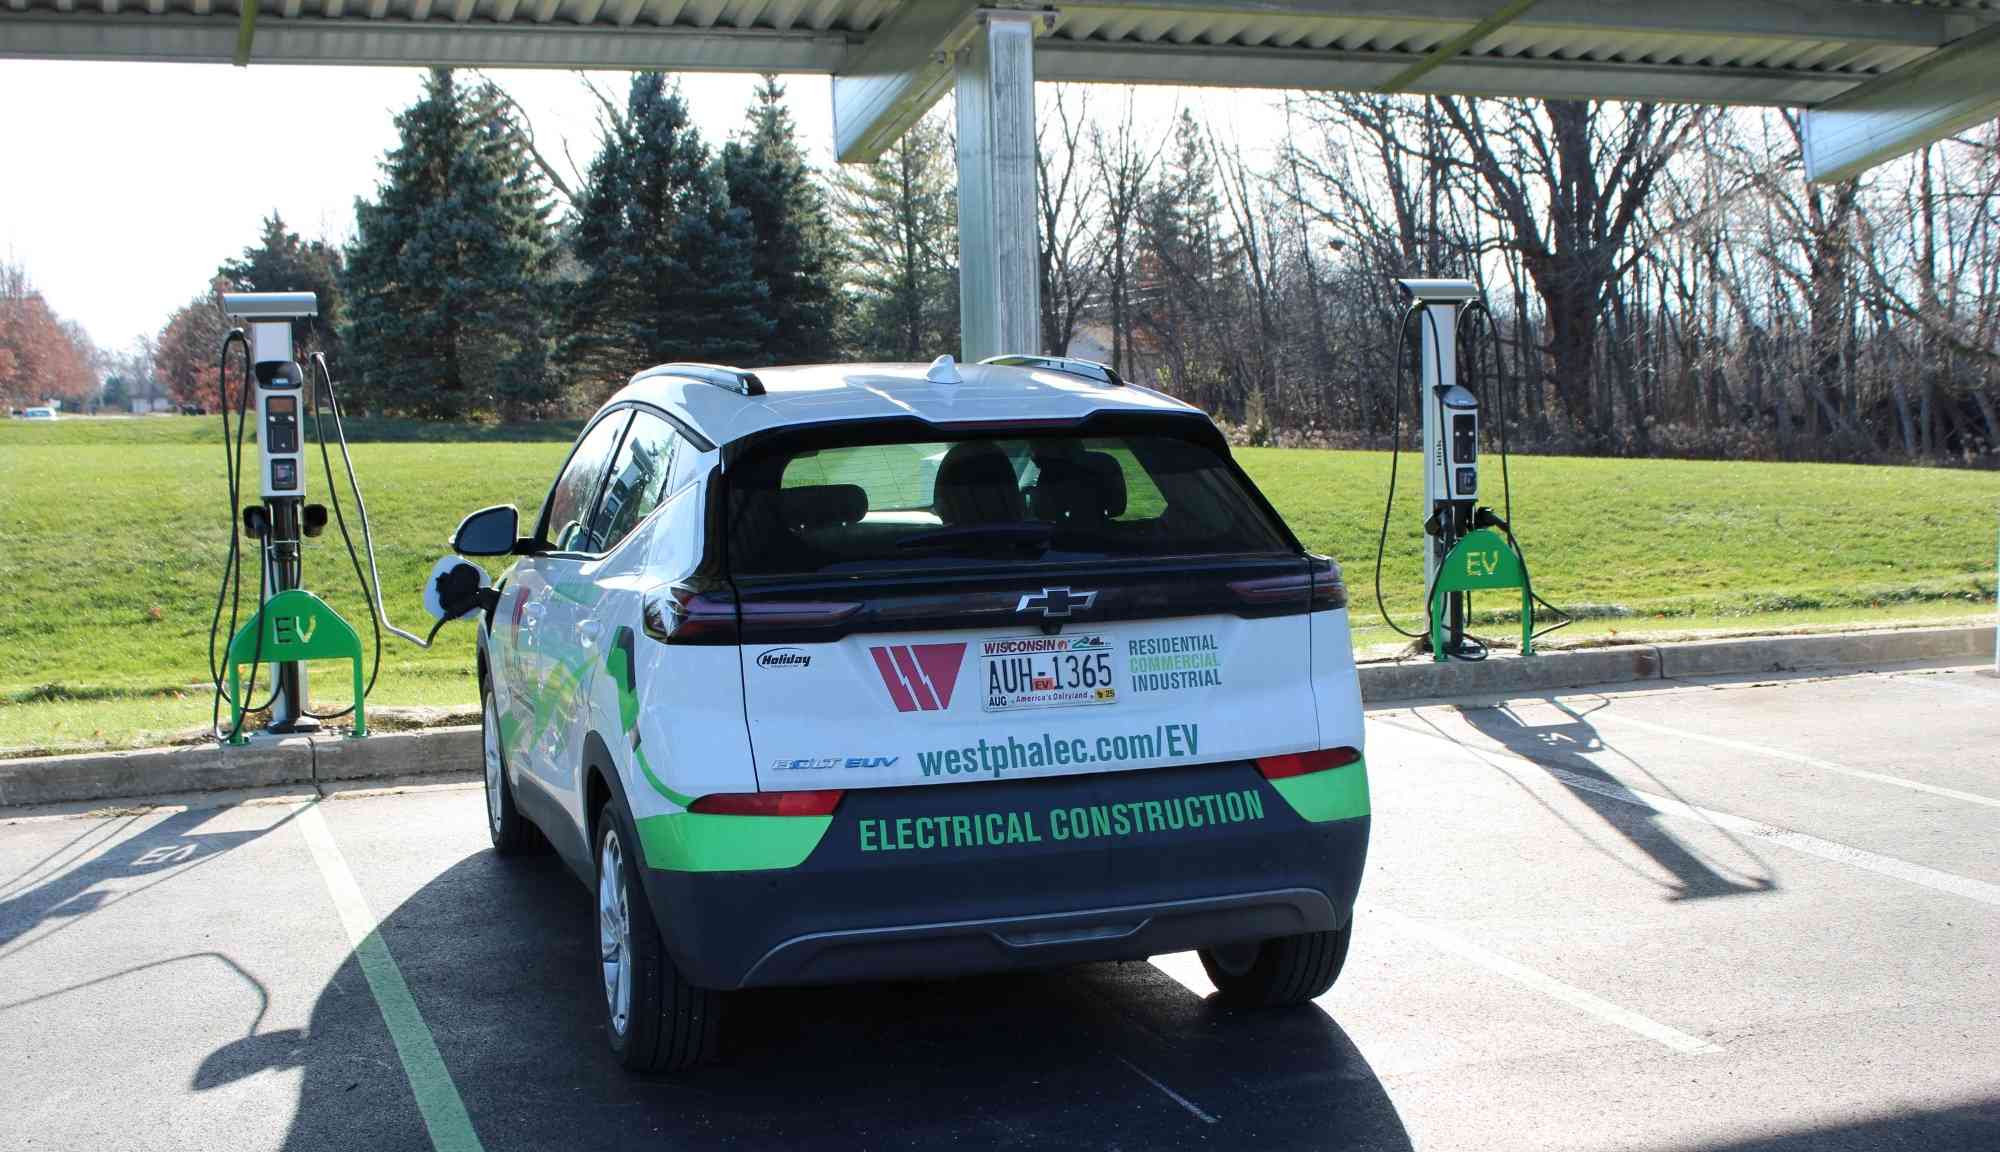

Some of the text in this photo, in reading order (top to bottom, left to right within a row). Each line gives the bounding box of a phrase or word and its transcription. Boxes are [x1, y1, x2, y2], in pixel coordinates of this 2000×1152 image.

[1466, 550, 1499, 576] EV
[272, 615, 316, 645] EV
[984, 639, 1056, 655] WISCONSIN
[1129, 634, 1218, 656] RESIDENTIAL
[762, 653, 811, 667] Holiday
[1130, 652, 1221, 673] COMMERCIAL
[1034, 680, 1050, 689] EV
[1132, 668, 1222, 692] INDUSTRIAL
[989, 695, 1007, 706] AUG
[918, 723, 1199, 778] westphalec.com/EV
[772, 756, 898, 769] BOLT EUV
[859, 789, 1265, 852] ELECTRICAL CONSTRUCTION
